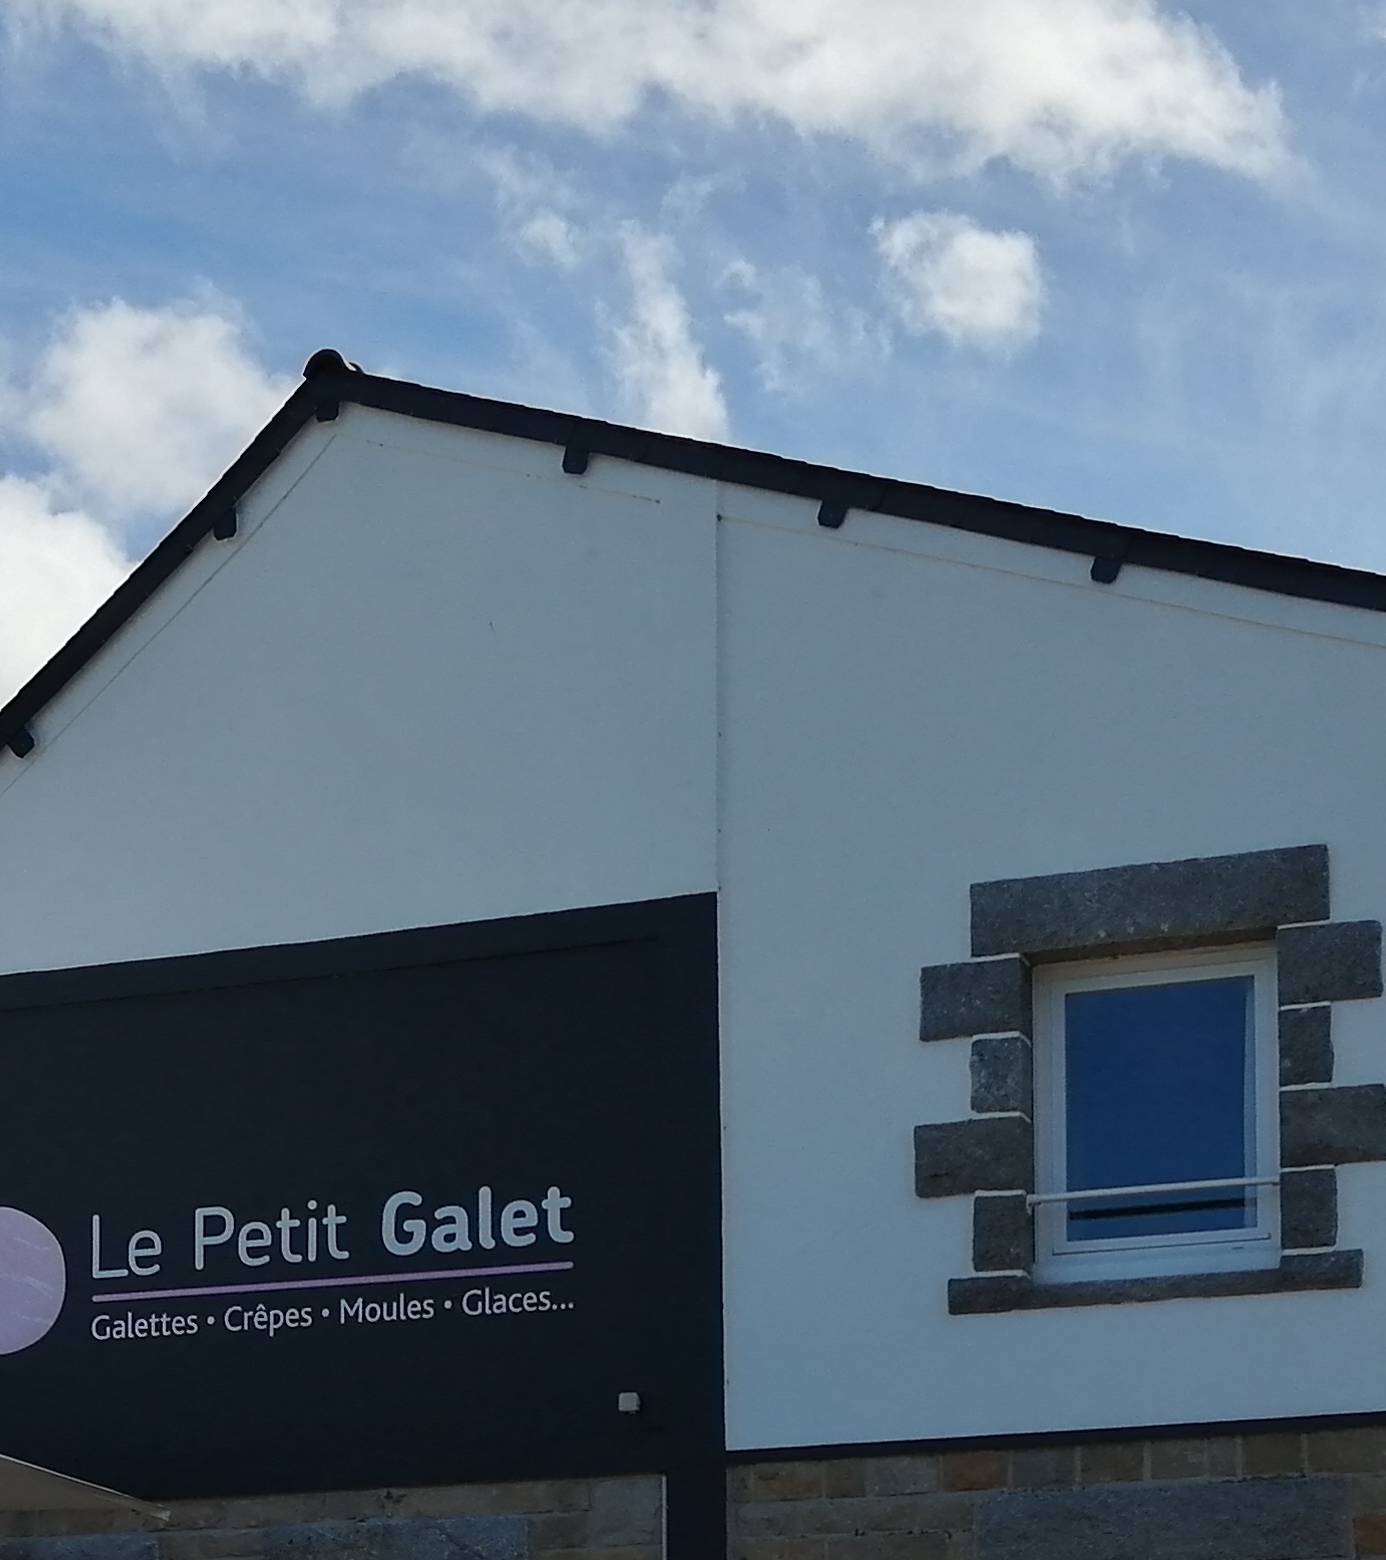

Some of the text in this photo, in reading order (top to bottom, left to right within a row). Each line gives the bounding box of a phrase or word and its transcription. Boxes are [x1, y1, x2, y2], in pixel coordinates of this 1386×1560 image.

[91, 1185, 576, 1280] Le Petit Galet
[91, 1309, 200, 1341] Galettes
[223, 1301, 313, 1337] Crêpes
[339, 1295, 436, 1326] Moules
